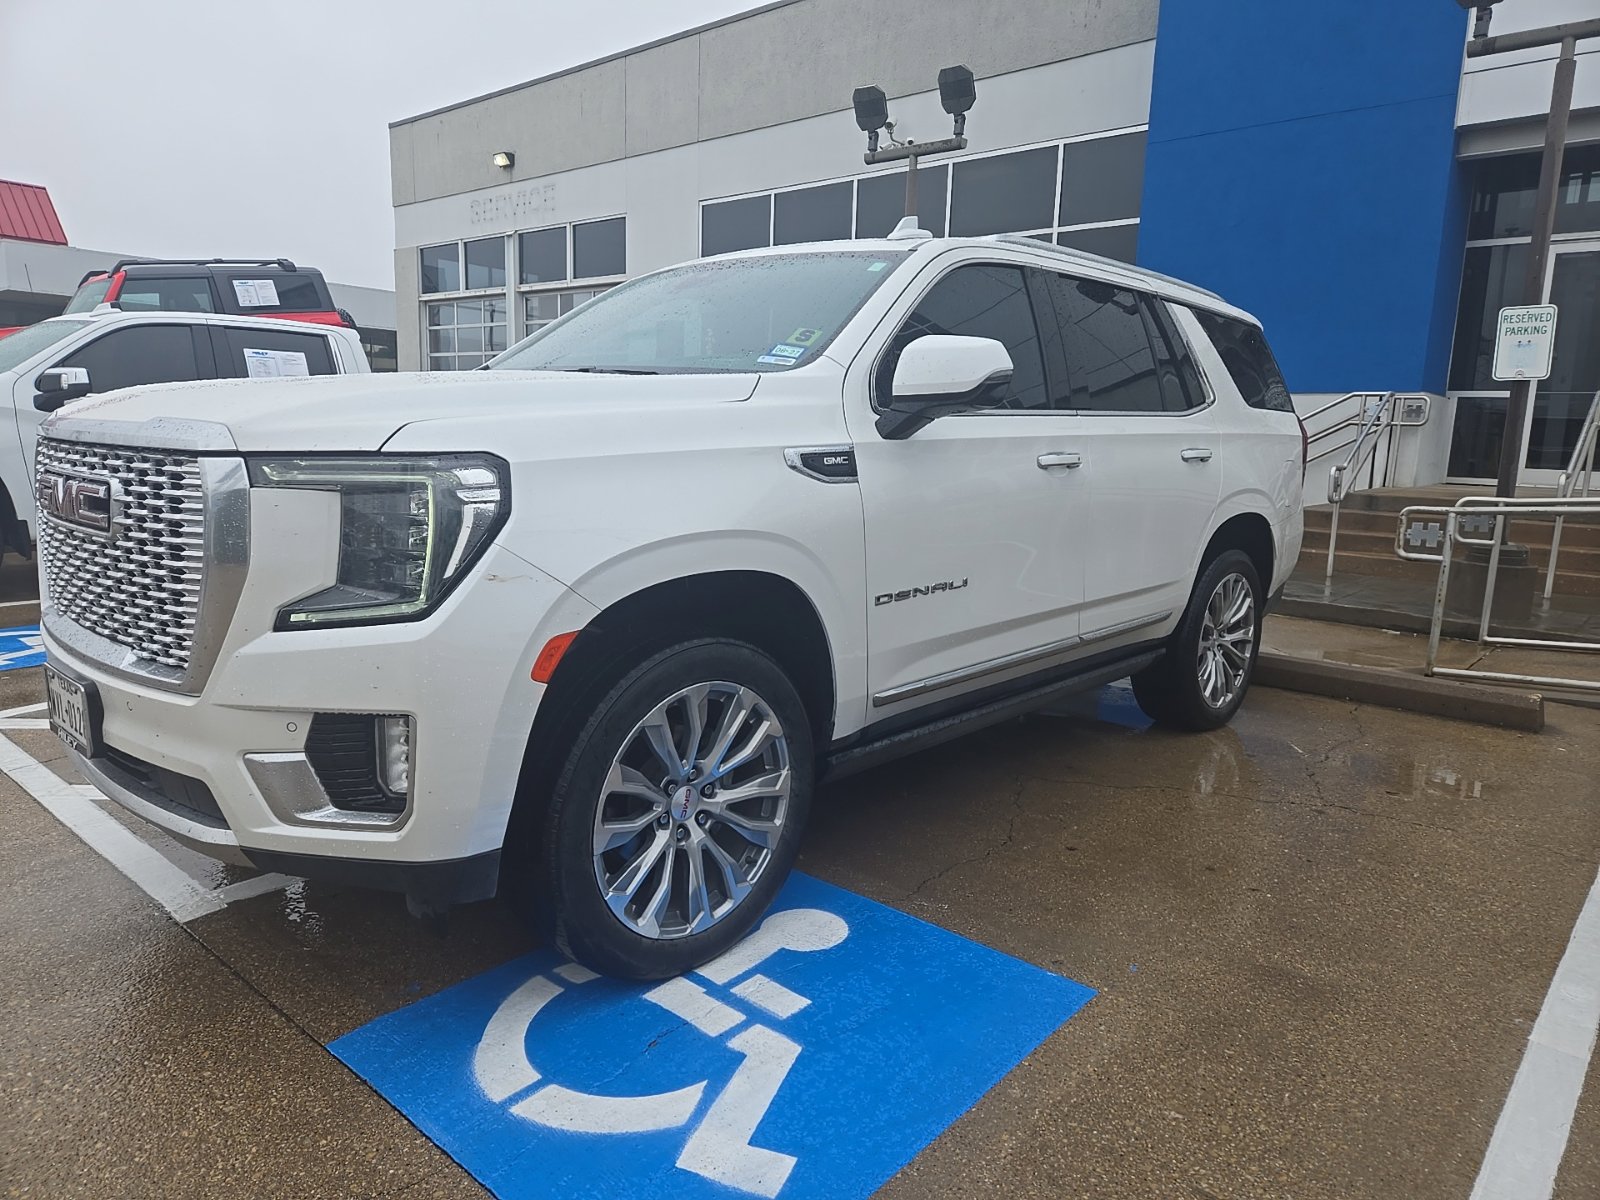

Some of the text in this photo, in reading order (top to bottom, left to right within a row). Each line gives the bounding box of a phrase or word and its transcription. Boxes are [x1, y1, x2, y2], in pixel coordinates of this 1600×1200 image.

[1503, 312, 1553, 324] RESERVED
[794, 329, 816, 342] S
[1504, 325, 1548, 337] PARKING
[823, 456, 849, 465] GMC
[39, 473, 109, 528] GMC
[874, 576, 968, 606] DENALI
[680, 788, 692, 819] GMC
